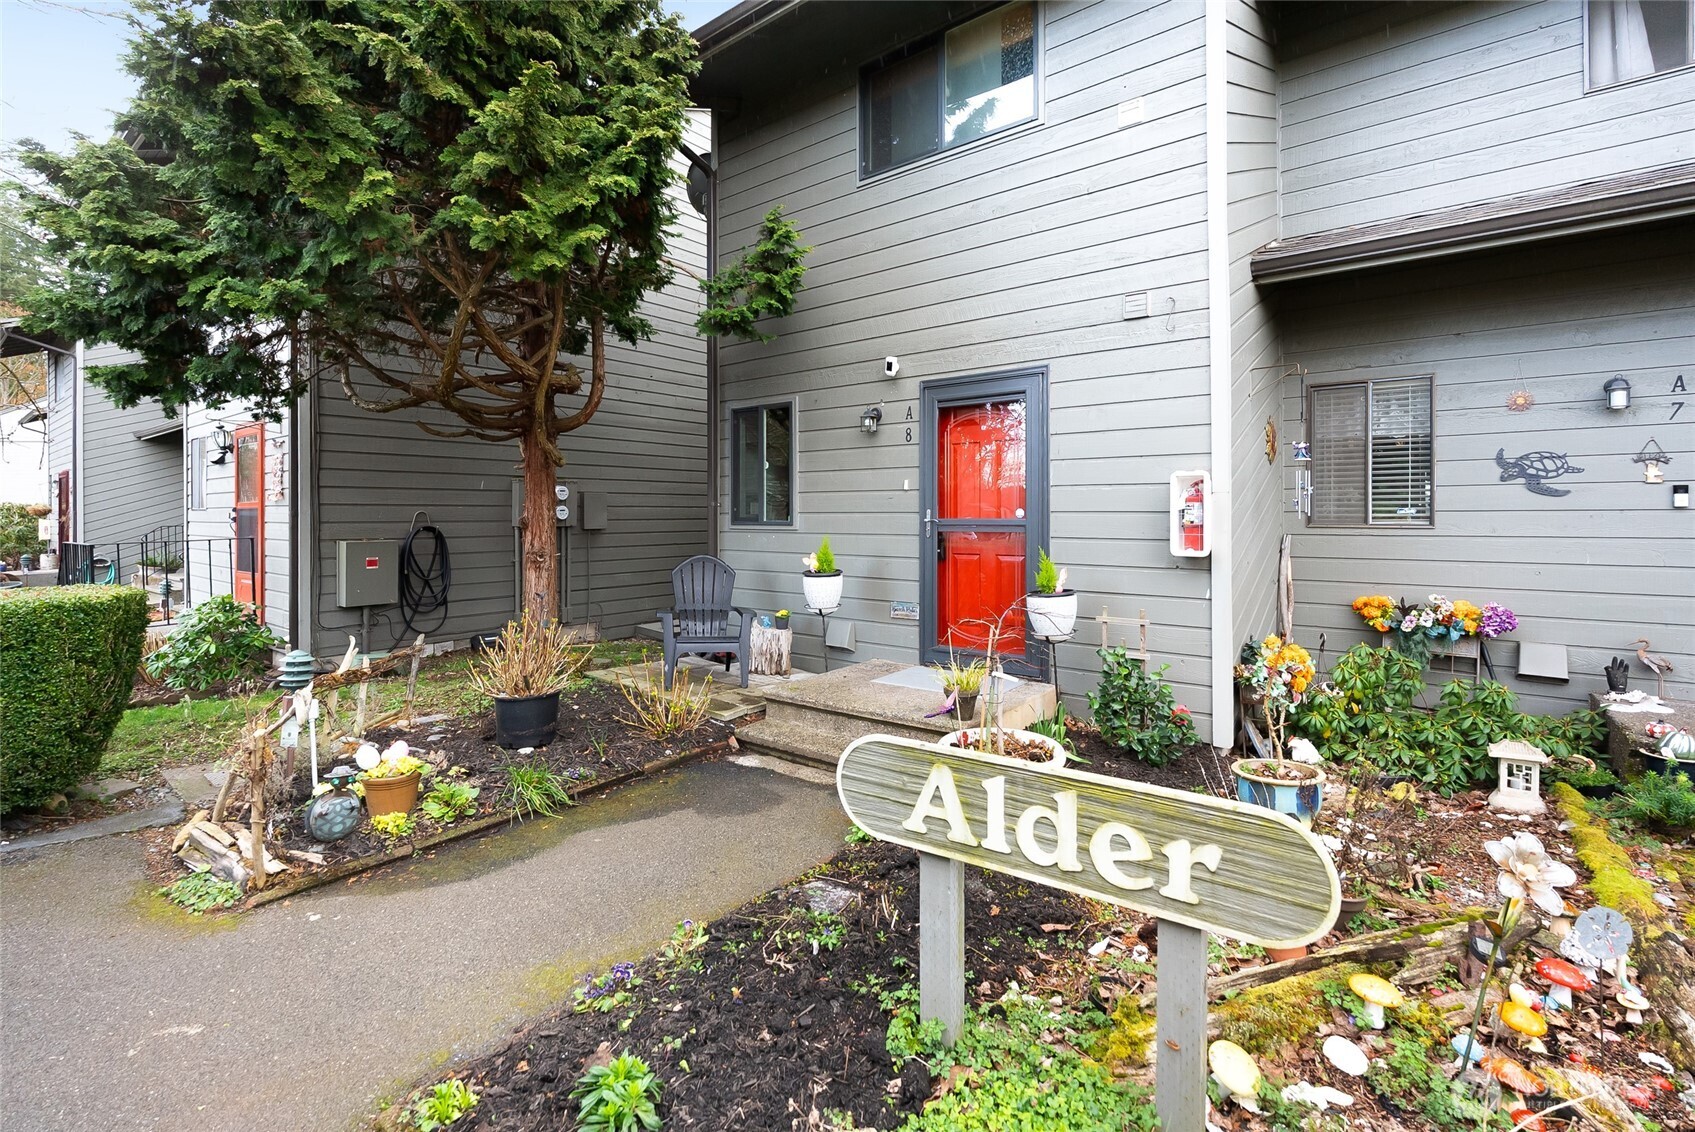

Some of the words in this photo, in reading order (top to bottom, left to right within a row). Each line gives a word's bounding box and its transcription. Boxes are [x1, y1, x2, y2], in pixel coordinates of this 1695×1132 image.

[1671, 375, 1687, 392] A
[905, 405, 913, 420] A
[1669, 402, 1685, 420] 7
[905, 427, 912, 442] 8
[901, 763, 1223, 905] Alder
